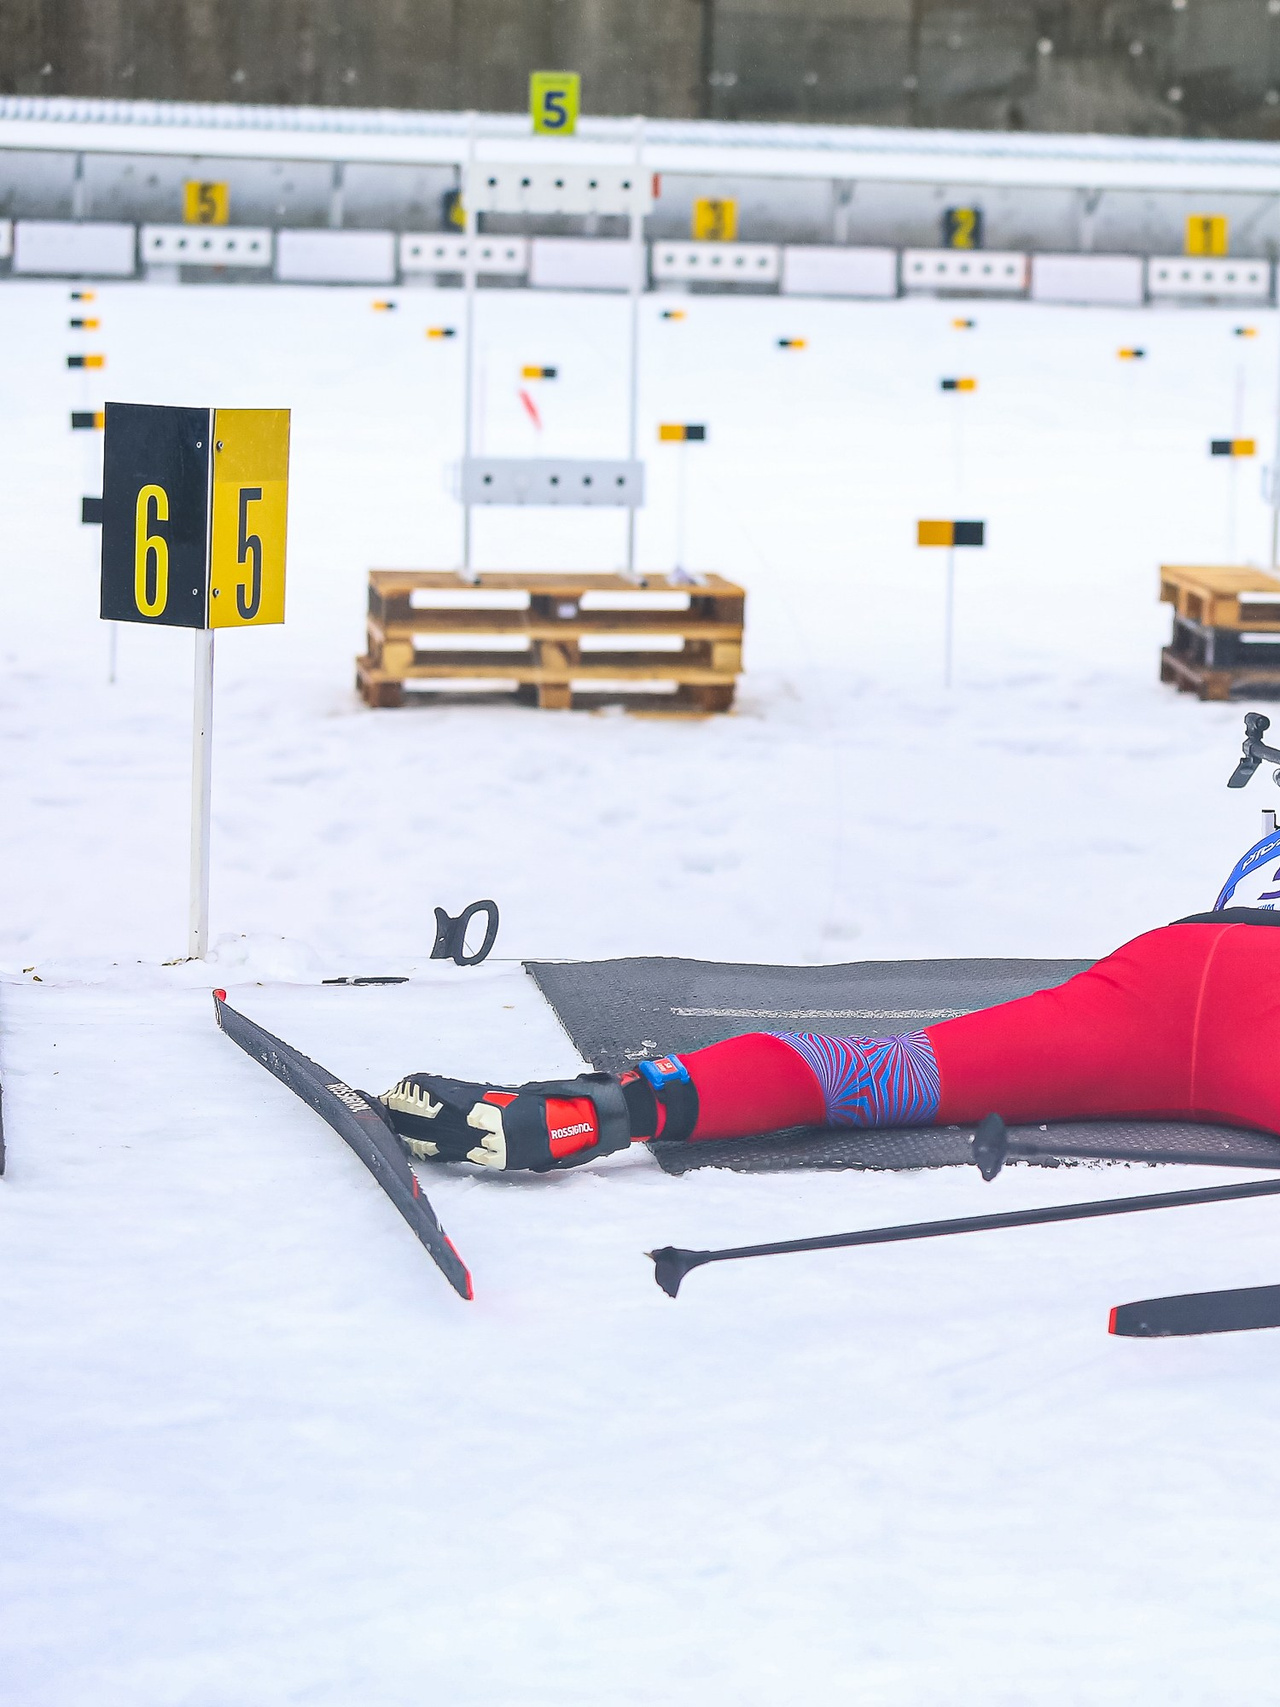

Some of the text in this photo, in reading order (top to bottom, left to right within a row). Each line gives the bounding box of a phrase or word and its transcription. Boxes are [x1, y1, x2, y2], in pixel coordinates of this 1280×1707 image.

[542, 91, 568, 129] 5
[197, 181, 217, 225] 5
[951, 208, 975, 250] 2
[134, 484, 170, 618] 6
[236, 487, 263, 620] 5
[550, 1122, 594, 1140] ROSSIGNOL
